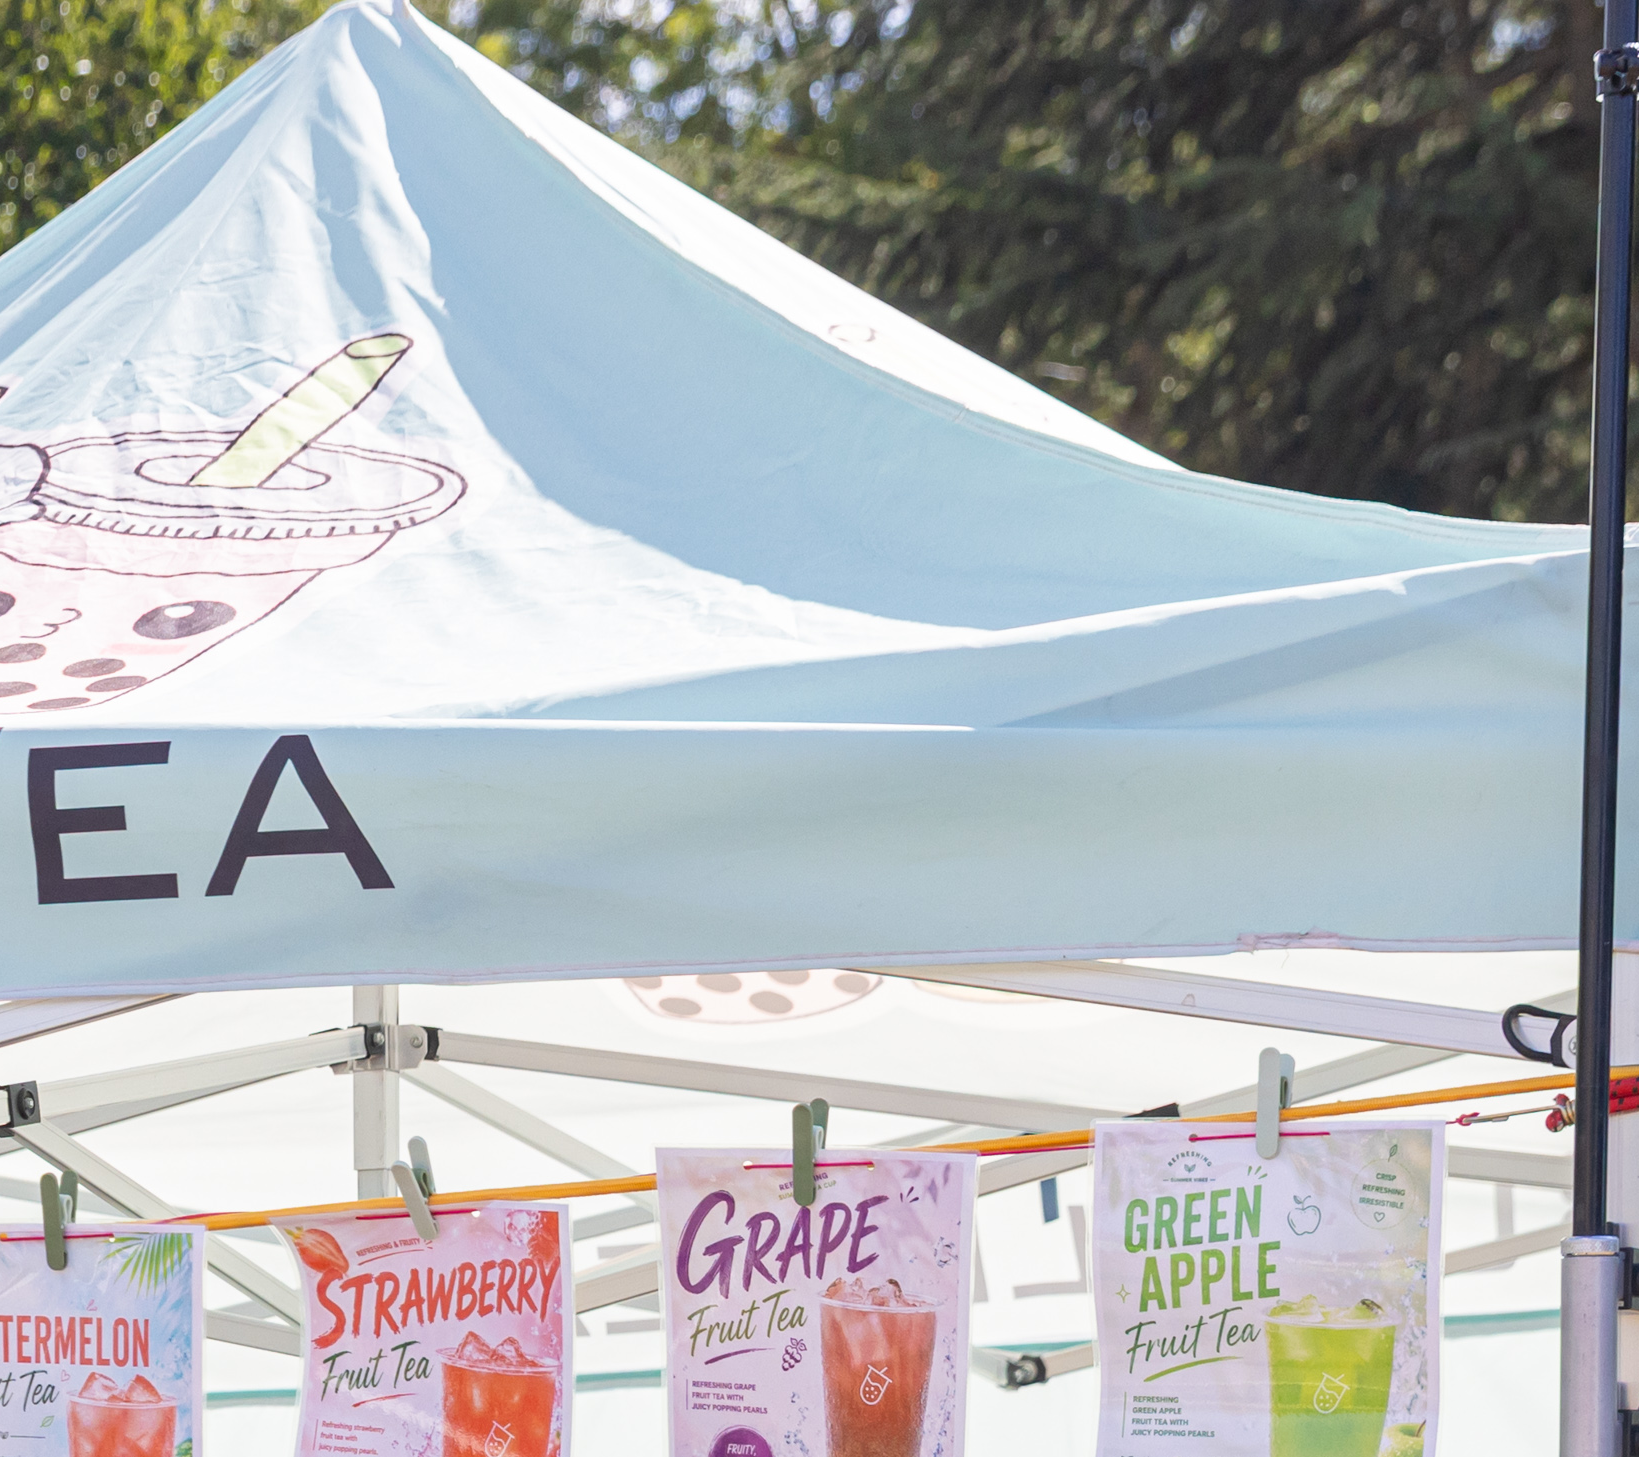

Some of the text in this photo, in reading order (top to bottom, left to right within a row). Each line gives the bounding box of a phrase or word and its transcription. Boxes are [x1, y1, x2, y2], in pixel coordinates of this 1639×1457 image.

[676, 1190, 889, 1299] GRAPE
[1124, 1184, 1262, 1253] GREEN
[311, 1257, 561, 1349] STRAWBERRY
[1139, 1241, 1281, 1312] APPLE
[688, 1288, 808, 1357] Fruit Tea
[1125, 1306, 1261, 1373] Fruit Tea
[20, 1370, 59, 1412] Tea
[321, 1340, 433, 1401] Fruit Tea
